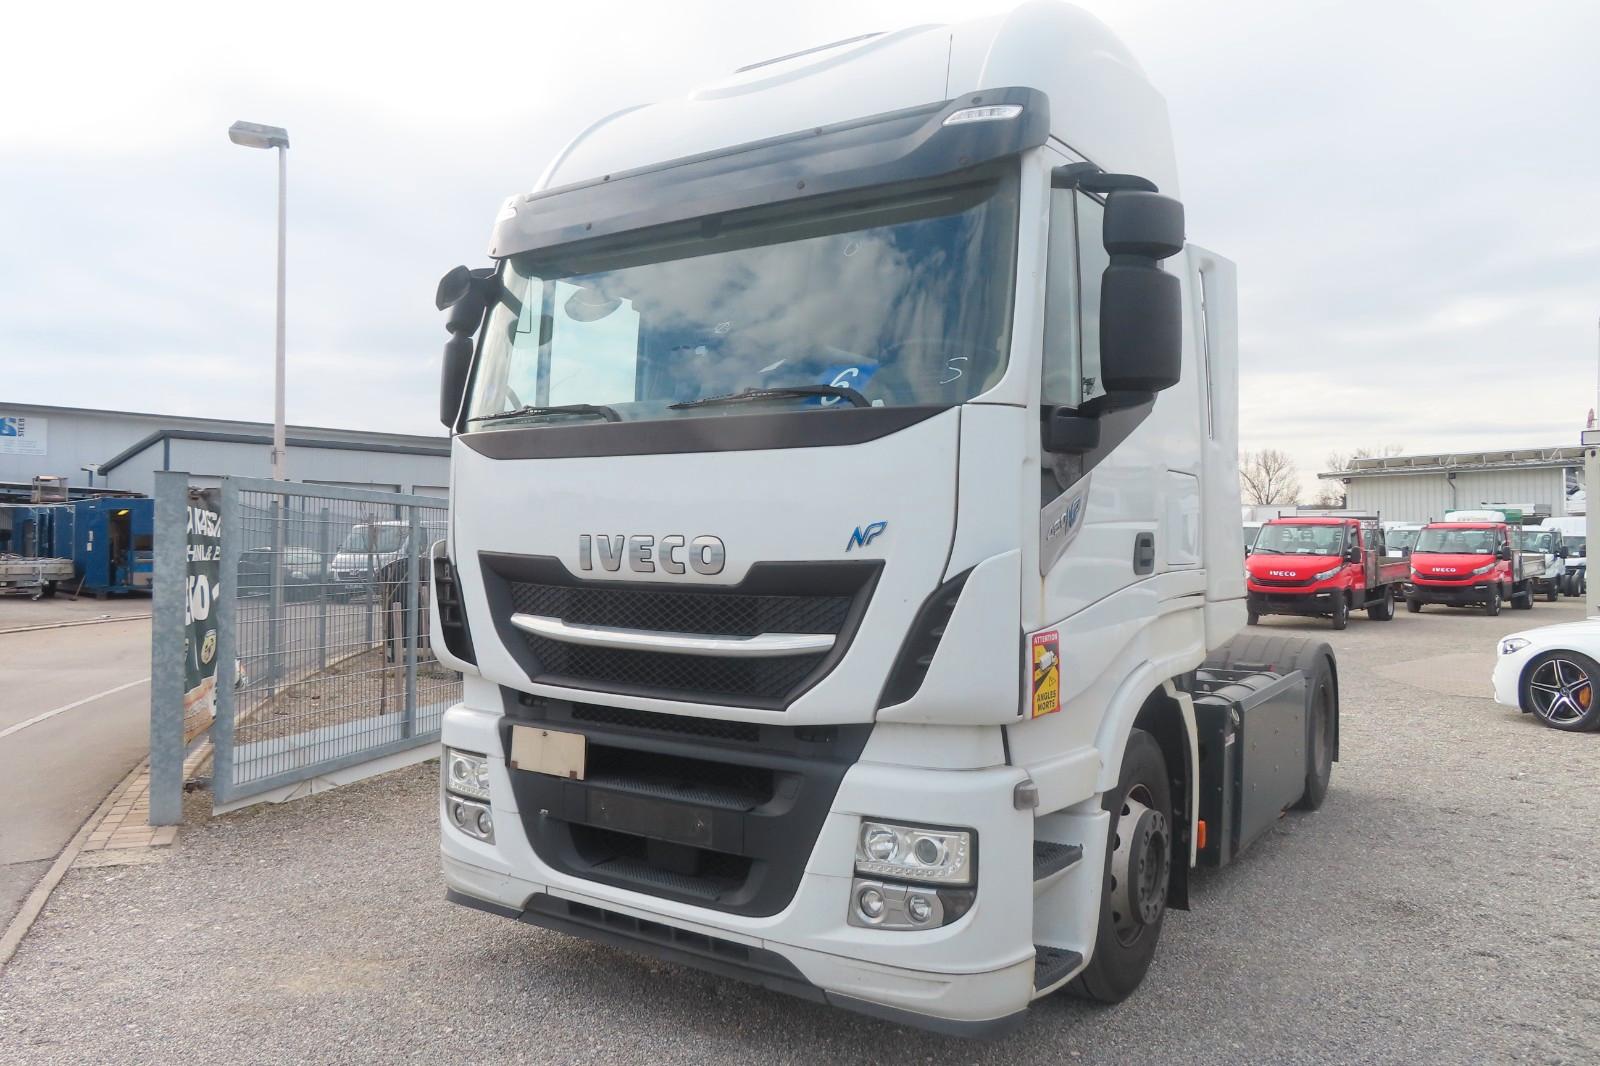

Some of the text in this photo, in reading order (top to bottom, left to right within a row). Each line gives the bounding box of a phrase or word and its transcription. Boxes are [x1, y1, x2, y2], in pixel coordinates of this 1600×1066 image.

[845, 520, 888, 552] NP
[579, 534, 726, 576] IVECO
[1034, 633, 1058, 644] ATTENTION
[1036, 690, 1056, 702] ANGLES
[1037, 699, 1056, 712] MORTS
